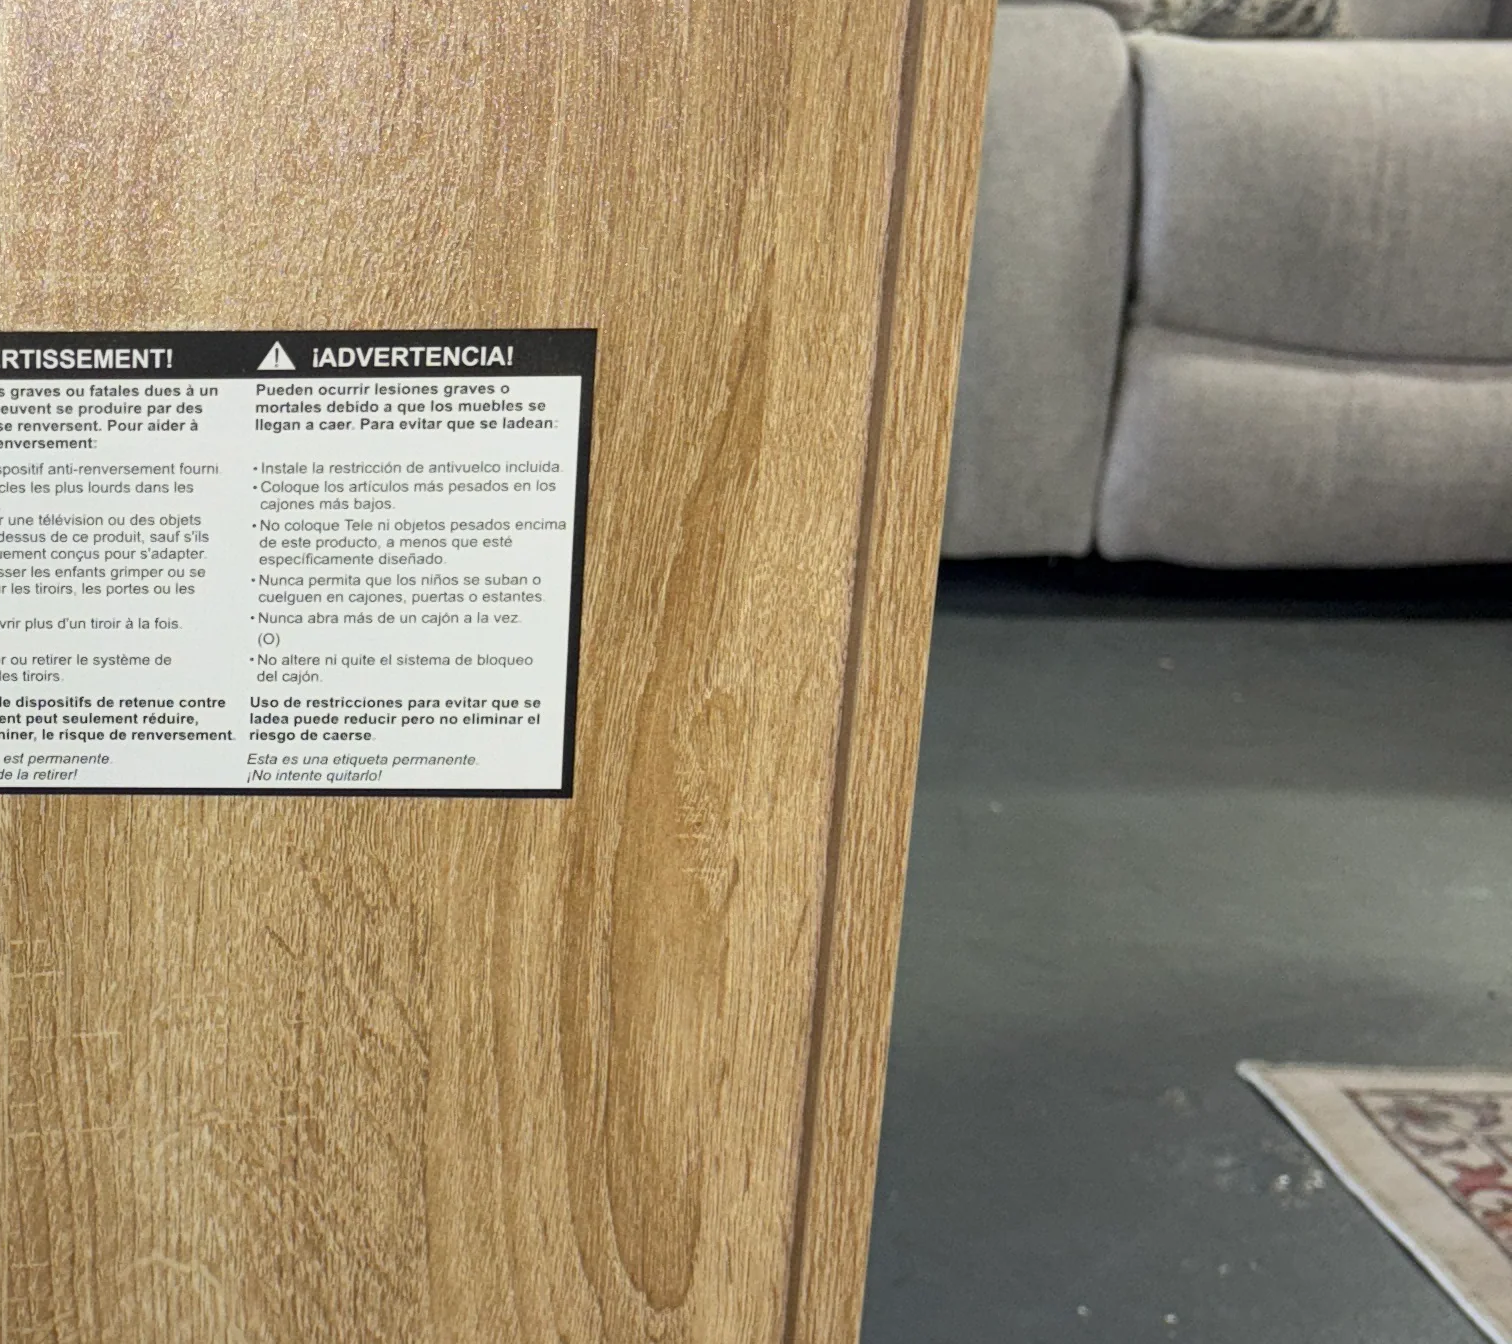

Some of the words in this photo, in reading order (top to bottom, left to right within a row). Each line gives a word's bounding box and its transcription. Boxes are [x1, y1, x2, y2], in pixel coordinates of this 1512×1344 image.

[9, 387, 62, 401] graves
[65, 387, 86, 398] ou
[88, 384, 140, 398] fatales
[144, 384, 182, 398] dues
[184, 383, 195, 398] à
[199, 386, 219, 398] un
[255, 383, 314, 397] Pueden
[317, 382, 371, 396] ocurrir
[374, 382, 439, 396] lesiones
[442, 384, 496, 398] graves
[499, 384, 511, 395] o
[55, 404, 74, 415] se
[78, 401, 142, 418] produire
[146, 404, 173, 418] par
[175, 401, 204, 415] des
[254, 400, 322, 414] mortales
[326, 400, 380, 414] debido
[382, 402, 393, 413] a
[396, 402, 426, 416] que
[430, 399, 454, 413] los
[457, 399, 524, 413] muebles
[527, 401, 547, 412] se
[106, 418, 144, 432] Pour
[146, 418, 187, 432] aider
[189, 418, 199, 432] à
[30, 480, 52, 494] les
[54, 480, 84, 497] plus
[87, 480, 132, 494] lourds
[134, 480, 170, 494] dans
[173, 480, 195, 494] les
[259, 518, 281, 532] No
[284, 518, 340, 534] coloque
[343, 518, 374, 532] Tele
[377, 518, 390, 532] ni
[394, 518, 446, 535] objetos
[449, 518, 511, 534] pesados
[514, 517, 567, 531] encima
[257, 632, 281, 648] (O)
[257, 653, 278, 666] No
[280, 653, 321, 666] altere
[324, 653, 338, 666] ni
[340, 654, 376, 669] quite
[379, 653, 392, 666] el
[396, 654, 451, 666] sistema
[454, 653, 473, 666] de
[476, 653, 534, 669] bloqueo
[14, 695, 93, 711] dispositifs
[96, 695, 115, 709] de
[118, 696, 175, 709] retenue
[178, 696, 227, 709] contre
[250, 696, 280, 709] Uso
[282, 696, 302, 709] de
[306, 696, 404, 709] restricciones
[407, 698, 441, 712] para
[444, 696, 488, 709] evitar
[490, 698, 520, 712] que
[523, 698, 542, 709] se
[25, 712, 58, 728] peut
[62, 712, 139, 725] seulement
[142, 712, 200, 727] réduire,
[249, 712, 290, 725] ladea
[293, 712, 340, 728] puede
[343, 712, 398, 725] reducir
[400, 715, 436, 728] pero
[439, 715, 459, 726] no
[462, 712, 524, 726] eliminar
[526, 712, 541, 726] el
[16, 768, 30, 781] la
[32, 768, 79, 781] retirer!
[246, 768, 272, 784] ¡No
[274, 768, 323, 782] intente
[326, 769, 383, 784] quitarlo!
